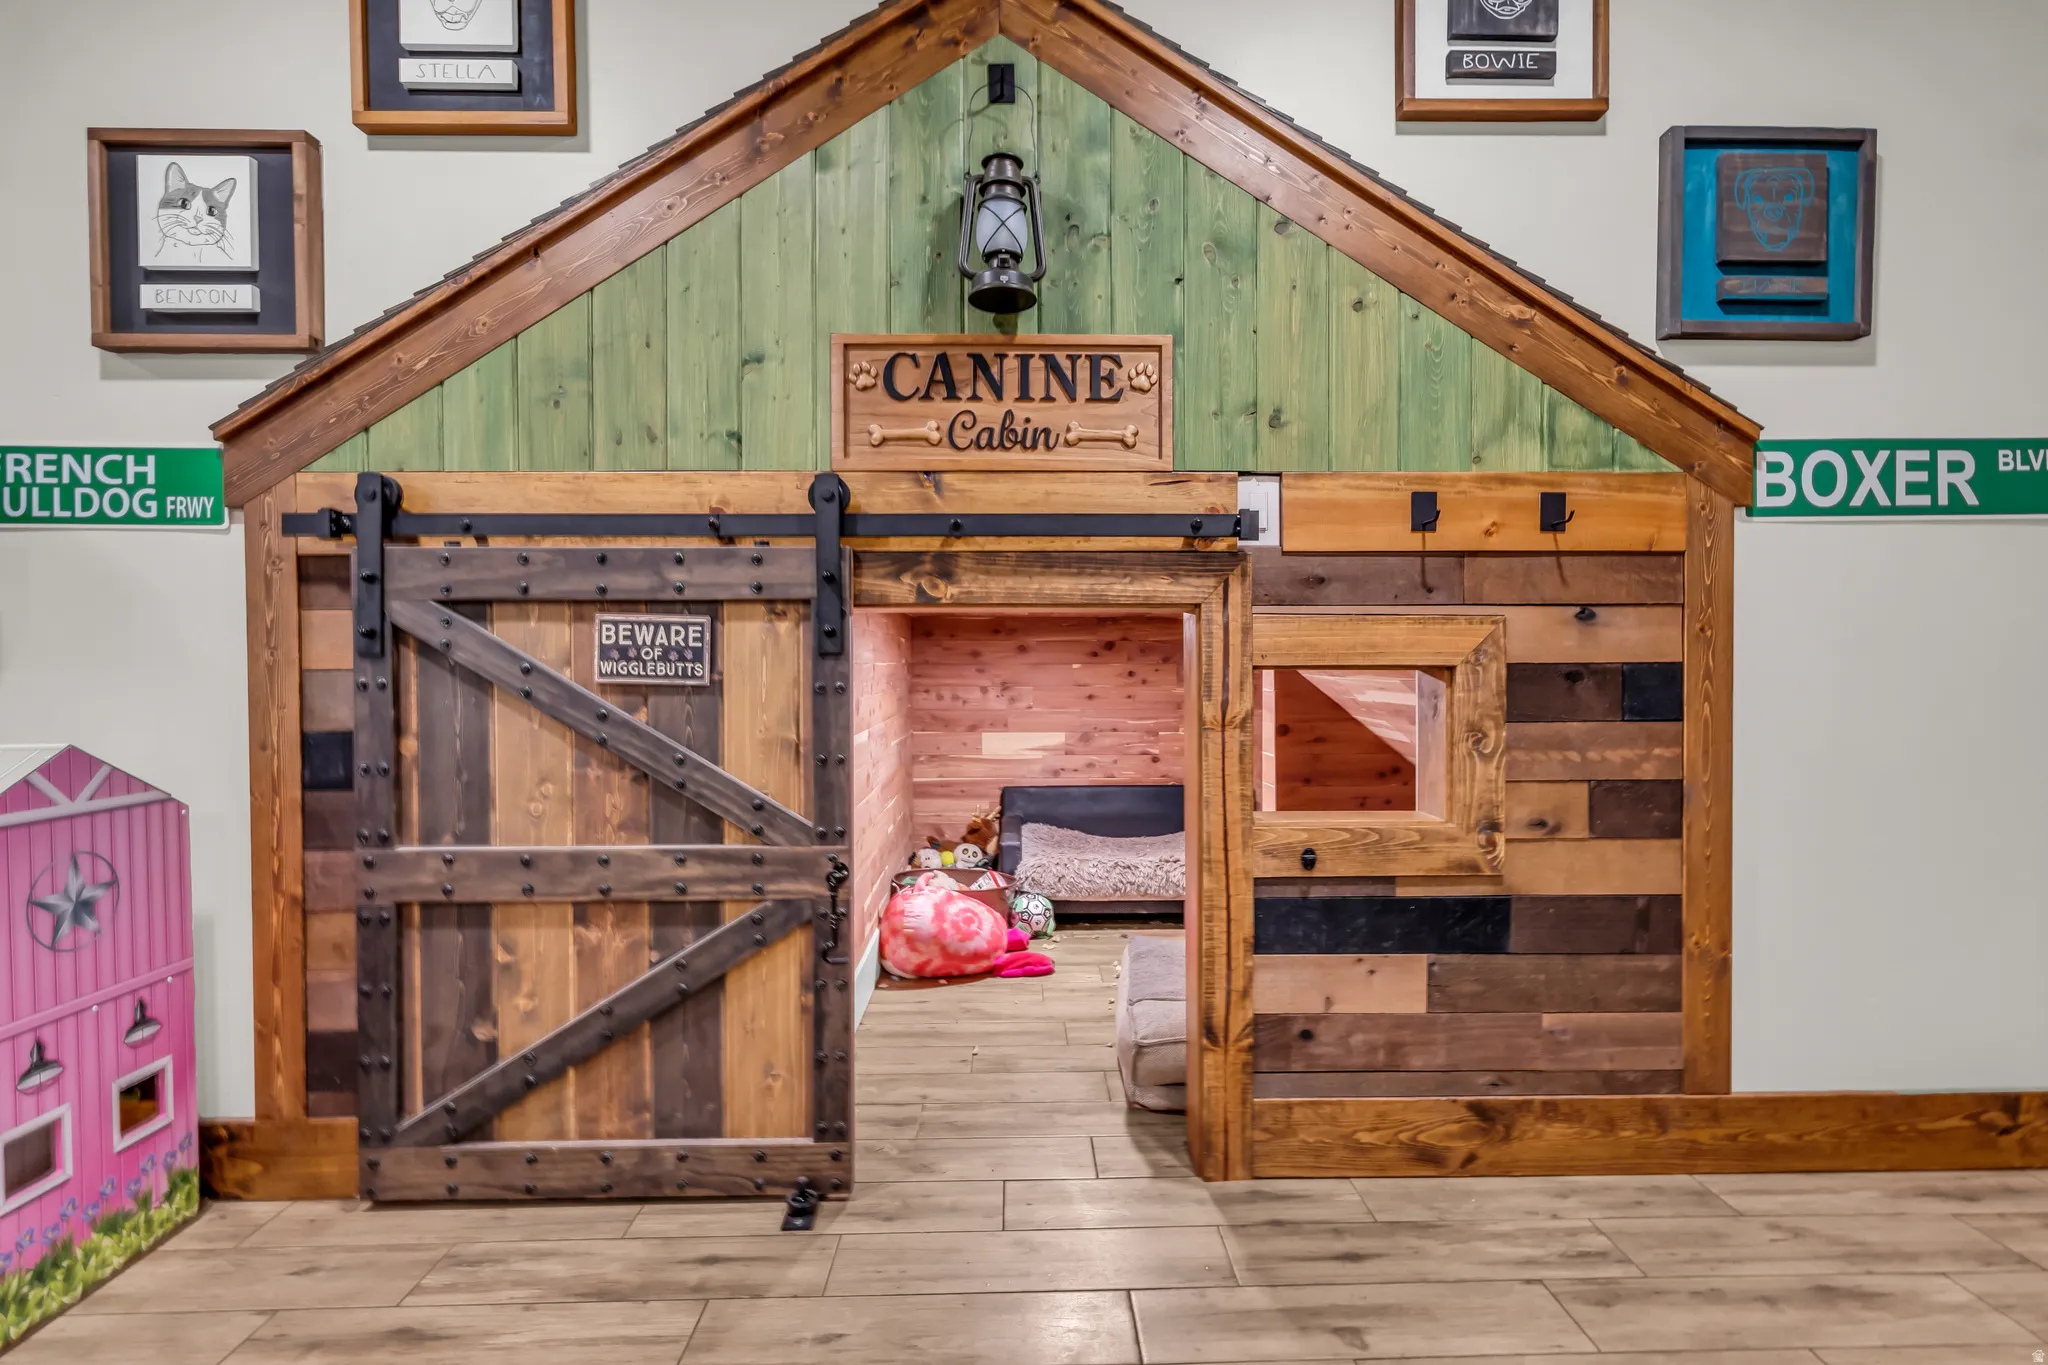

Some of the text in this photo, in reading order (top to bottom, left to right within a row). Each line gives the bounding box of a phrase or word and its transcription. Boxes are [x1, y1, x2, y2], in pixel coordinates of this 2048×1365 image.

[415, 63, 496, 79] STELLA
[1462, 52, 1540, 69] BOWIE
[155, 288, 237, 304] BENSON
[882, 351, 1124, 402] CANINE
[947, 408, 1060, 451] Cabin
[0, 453, 156, 485] RENCH
[1756, 449, 2048, 508] BOXER BLV
[2, 486, 215, 518] ULLDOG FRWY
[601, 623, 703, 648] BEWARE
[641, 647, 663, 661] OF
[600, 661, 704, 677] WIGGLEBUTTS
